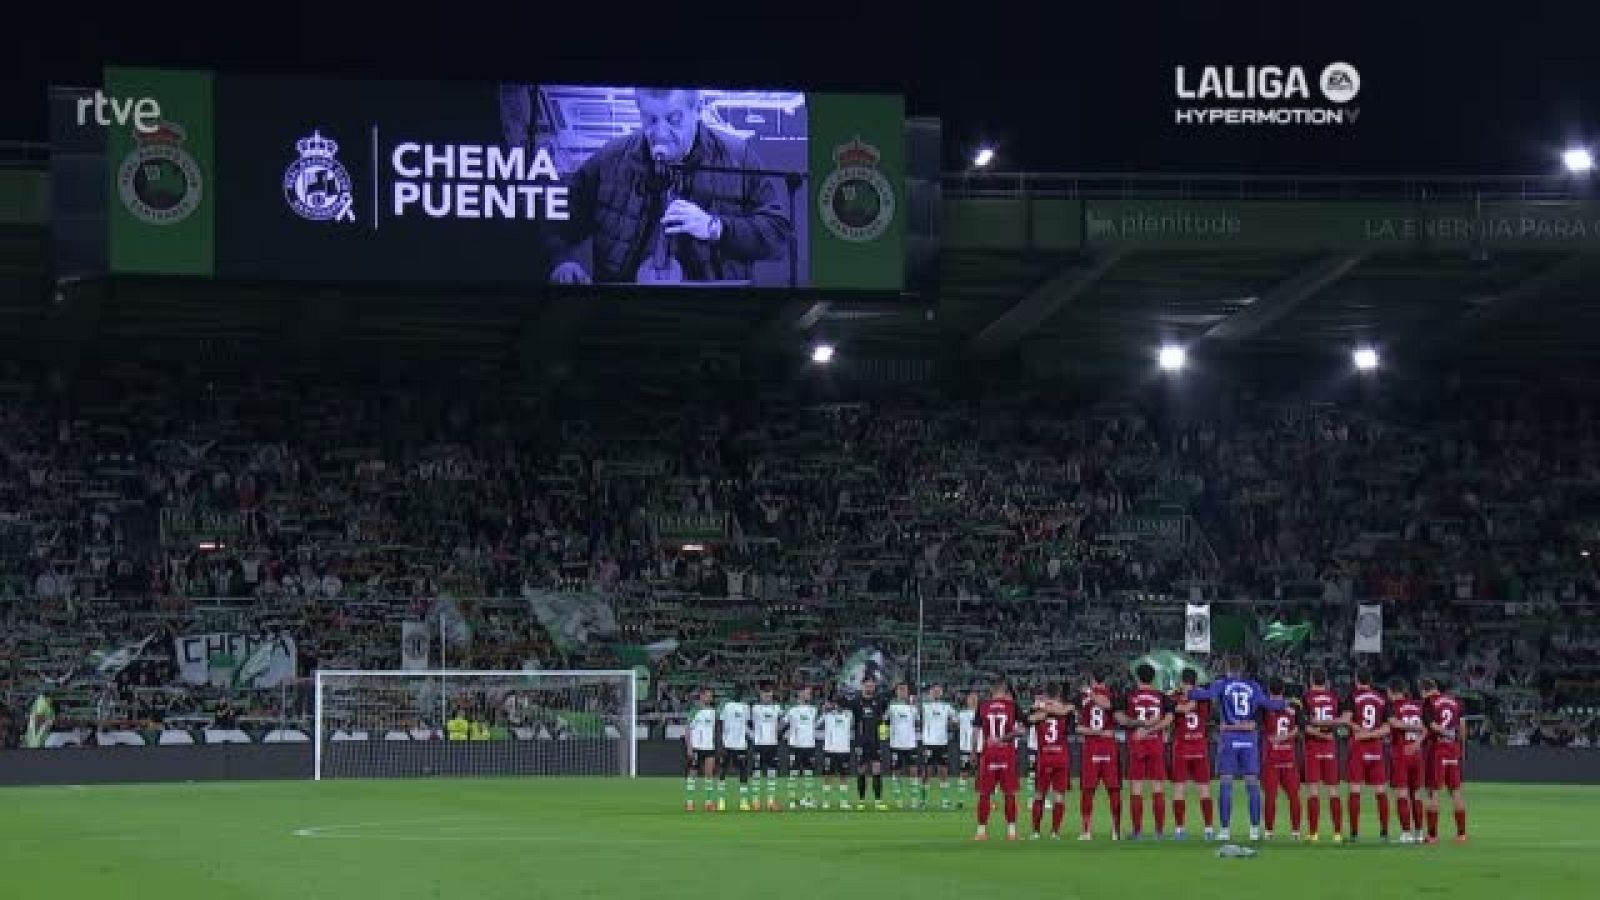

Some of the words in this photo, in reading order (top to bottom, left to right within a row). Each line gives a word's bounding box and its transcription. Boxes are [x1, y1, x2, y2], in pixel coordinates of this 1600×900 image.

[392, 142, 560, 181] CHEMA
[394, 181, 570, 220] PUENTE
[1121, 208, 1240, 238] plenitude
[1521, 218, 1586, 237] PARA
[1233, 692, 1249, 716] 13
[1362, 704, 1376, 728] 9
[987, 714, 1008, 738] 17
[1090, 706, 1104, 731] 8
[1044, 719, 1058, 743] 3
